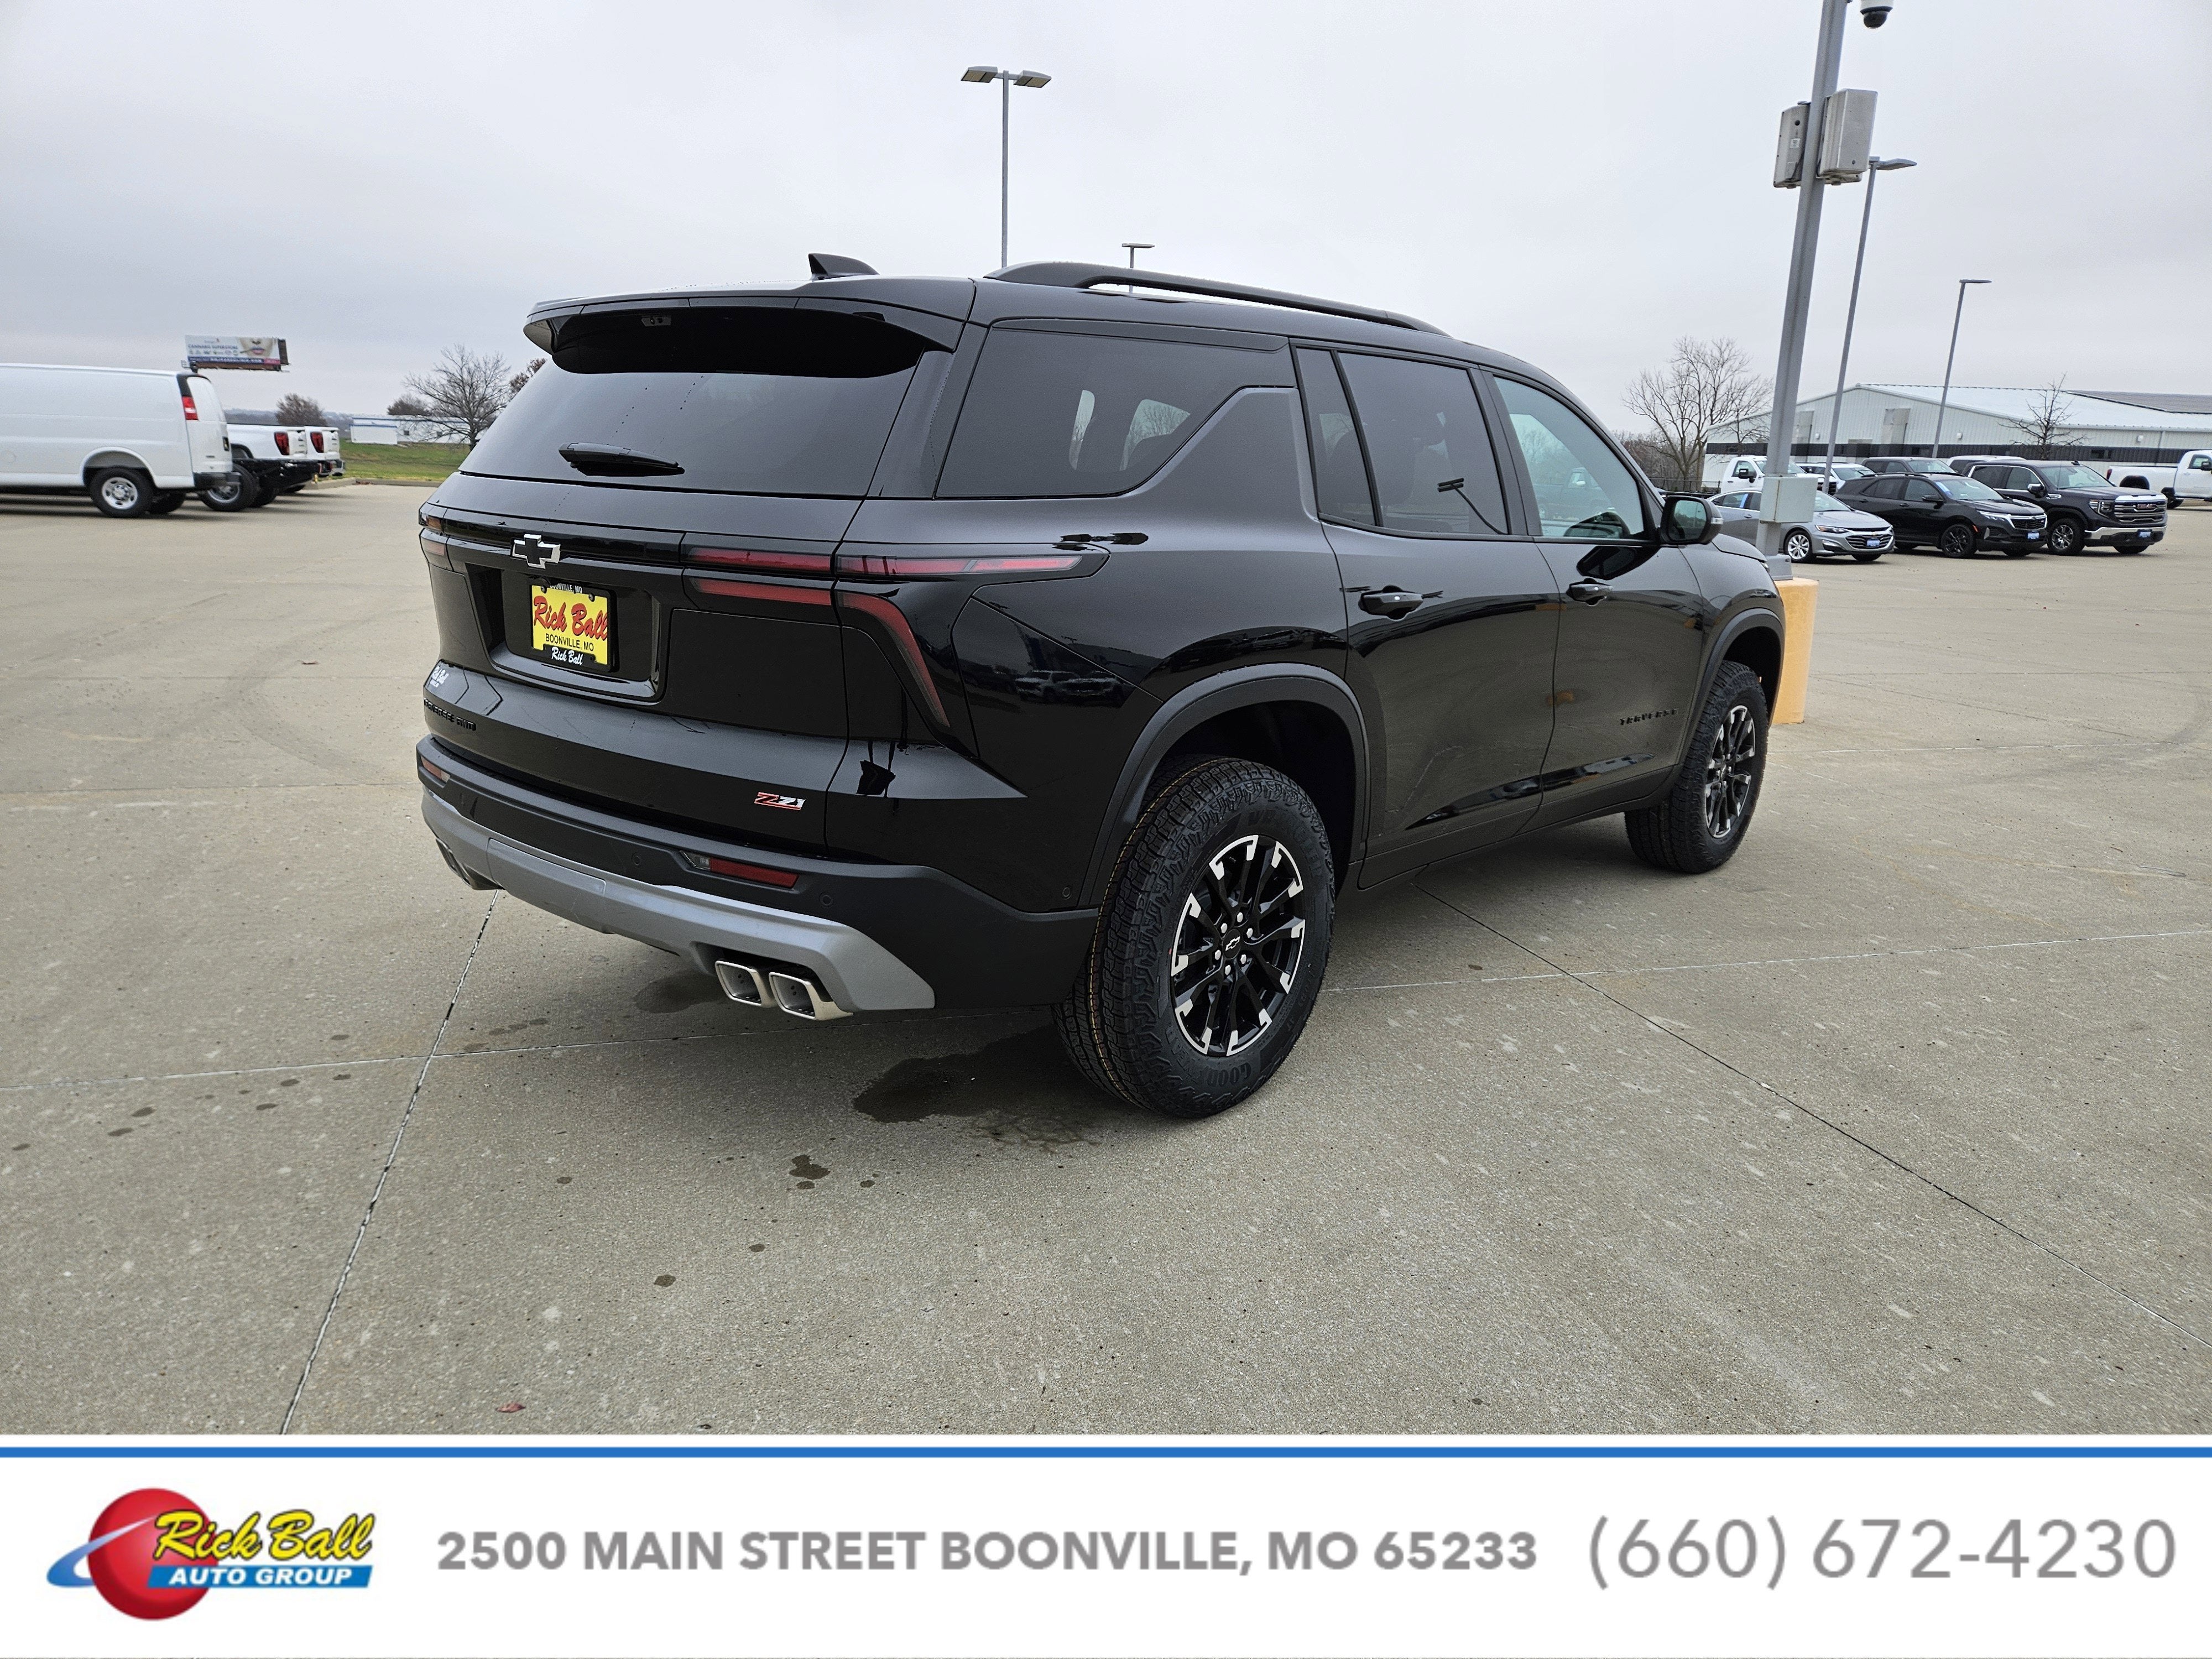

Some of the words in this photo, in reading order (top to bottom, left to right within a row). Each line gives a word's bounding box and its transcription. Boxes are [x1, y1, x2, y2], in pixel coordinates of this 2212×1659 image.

[534, 596, 567, 632] Rick
[571, 603, 608, 641] Ball
[545, 633, 582, 650] BOONVILLE,
[583, 641, 594, 651] MO
[551, 647, 567, 662] Rick
[568, 650, 583, 665] Ball
[754, 791, 806, 811] Z71
